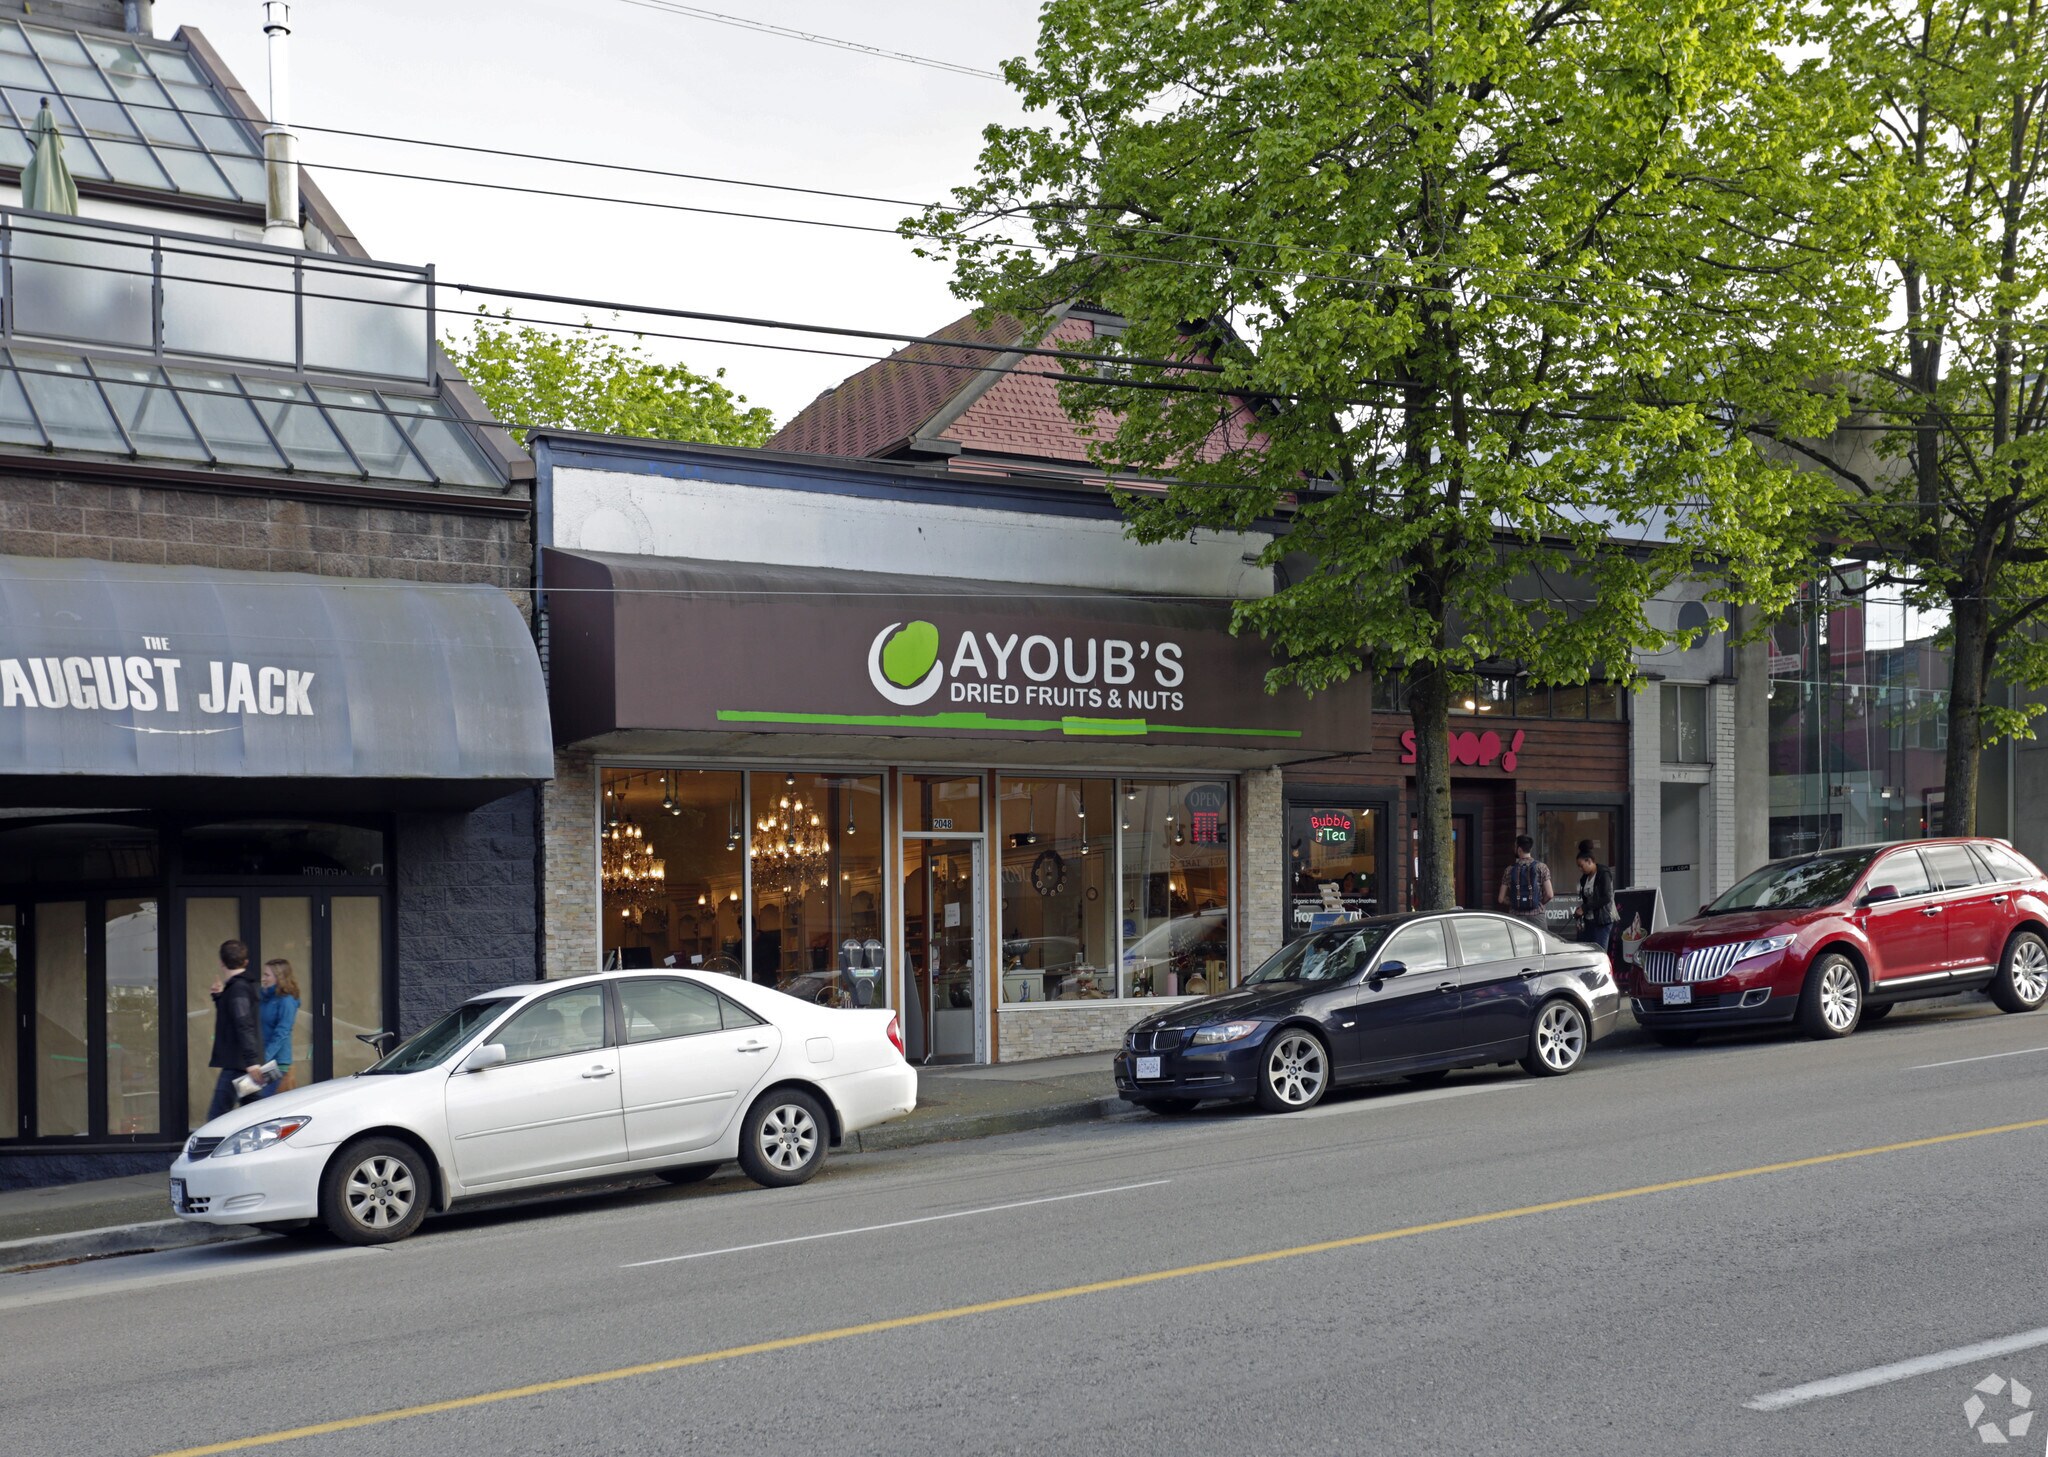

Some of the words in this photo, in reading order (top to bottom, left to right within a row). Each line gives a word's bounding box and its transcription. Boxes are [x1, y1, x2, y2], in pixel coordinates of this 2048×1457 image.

[142, 636, 171, 651] THE
[950, 631, 1184, 687] AYOUB'S
[0, 656, 181, 712] AUGUST
[199, 661, 315, 716] JACK
[951, 682, 1019, 704] DRIED
[1026, 686, 1102, 708] FRUITS
[1107, 689, 1122, 708] &
[1128, 690, 1184, 711] NUTS
[1190, 791, 1220, 806] OPEN
[934, 820, 952, 829] 2048
[1311, 814, 1351, 829] Bubble
[1323, 828, 1347, 841] Tea
[1544, 908, 1569, 920] rozen
